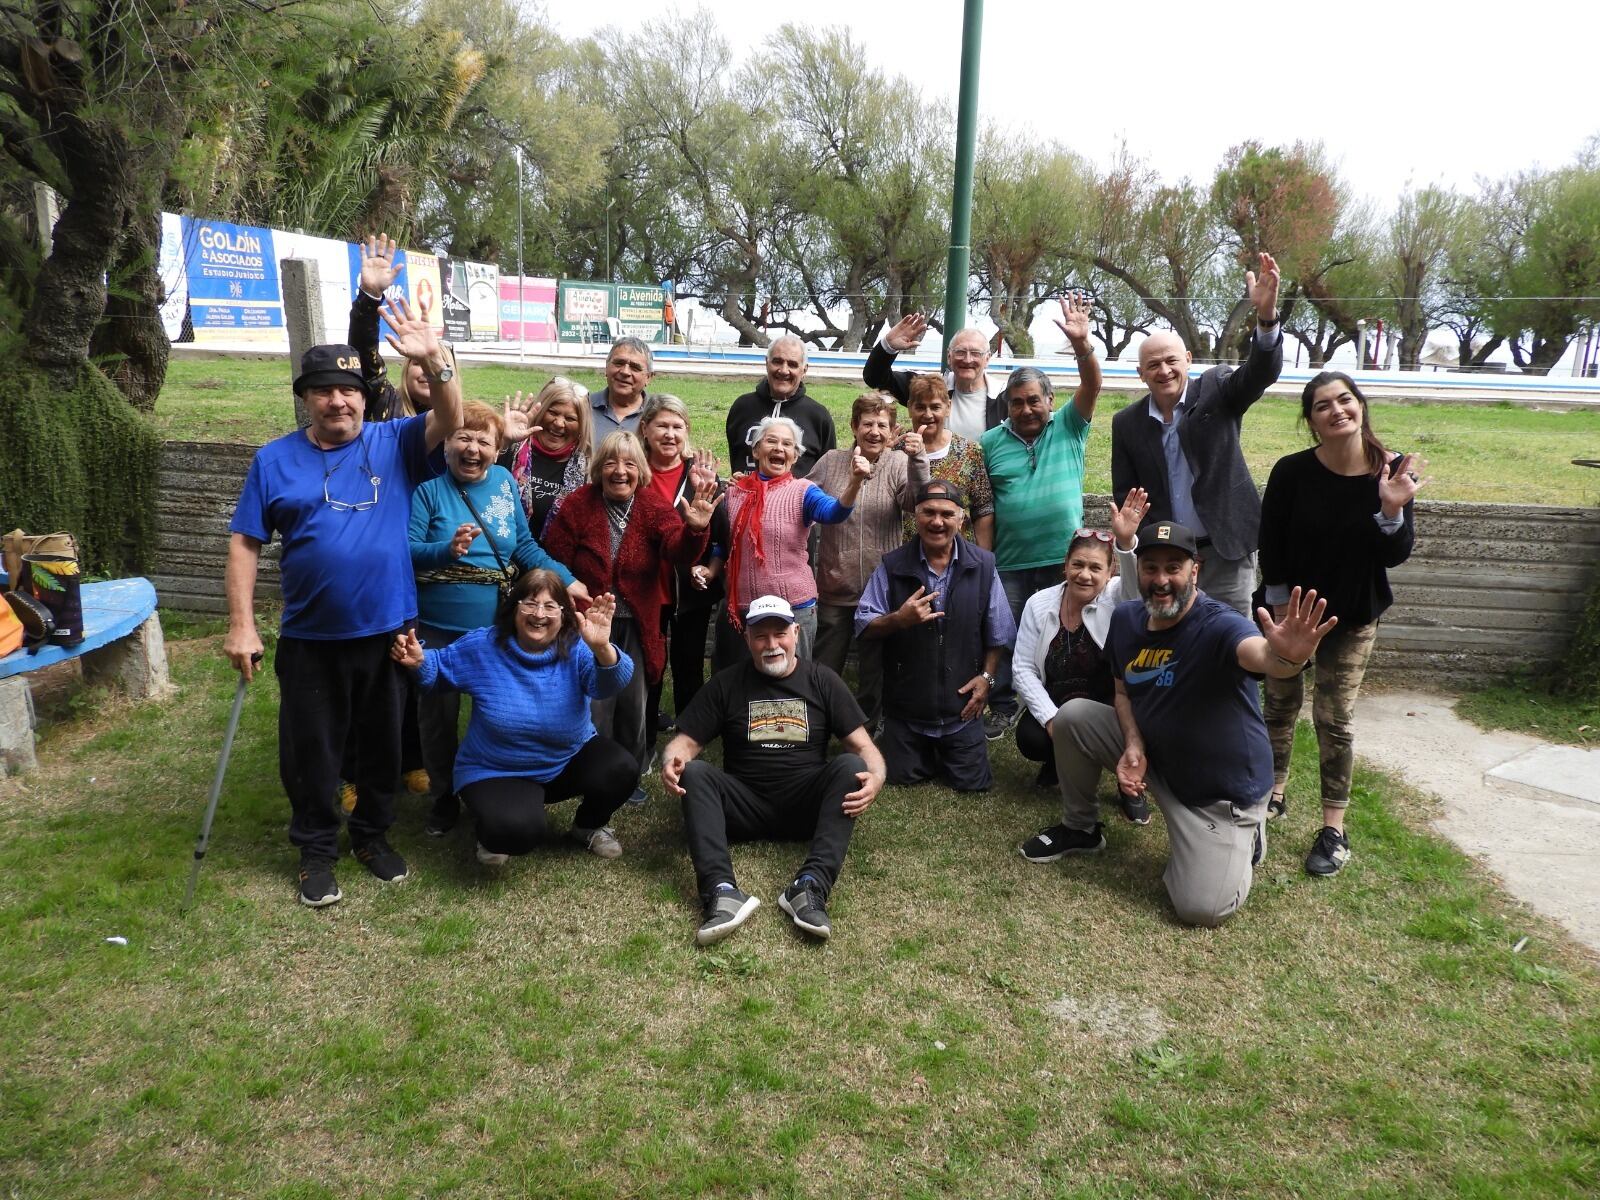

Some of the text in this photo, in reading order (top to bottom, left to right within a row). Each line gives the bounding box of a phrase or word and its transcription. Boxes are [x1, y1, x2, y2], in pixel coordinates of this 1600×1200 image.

[199, 226, 261, 254] GOLDÍN
[209, 250, 263, 267] ASOCIADOS
[203, 267, 234, 277] ESTUDIO
[620, 288, 663, 302] la Avenida
[1132, 648, 1173, 668] NIKE
